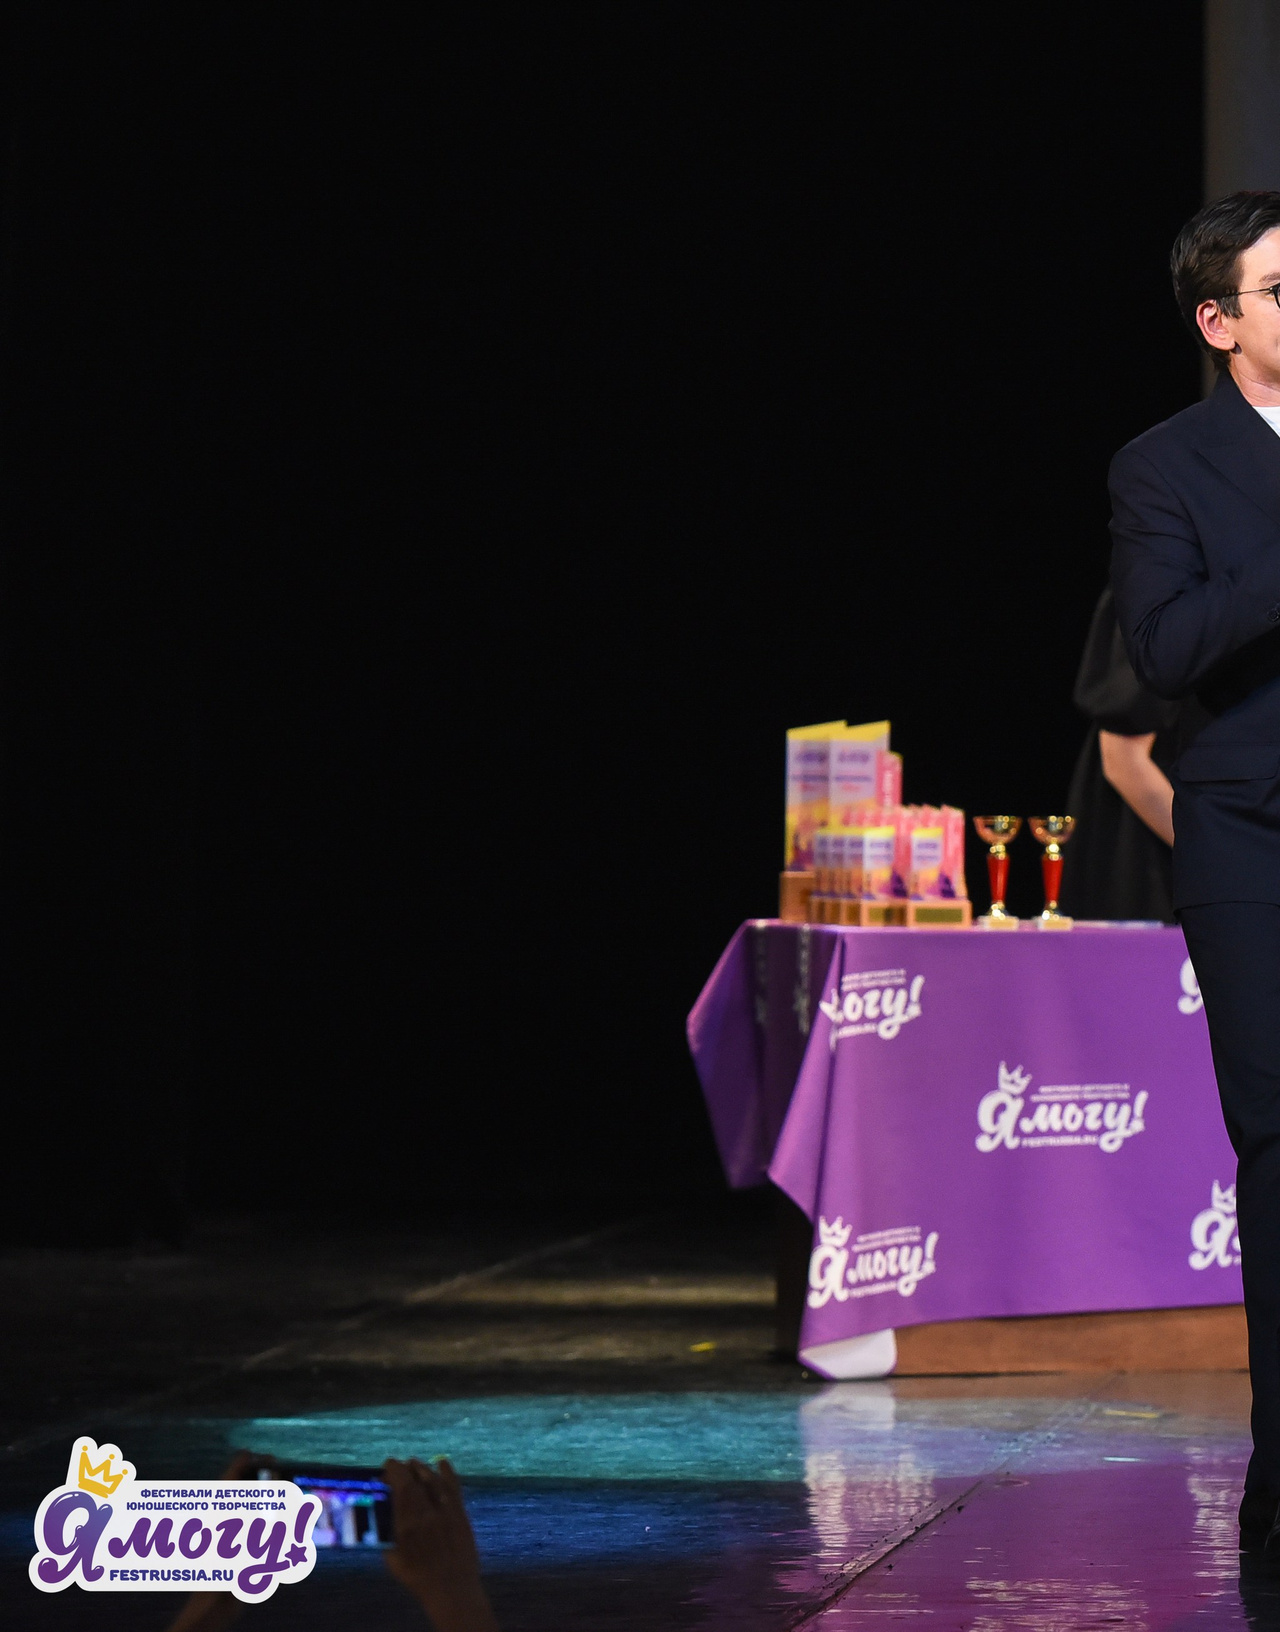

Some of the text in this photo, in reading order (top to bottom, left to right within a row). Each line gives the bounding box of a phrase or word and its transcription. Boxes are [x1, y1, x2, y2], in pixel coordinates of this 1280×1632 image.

[975, 1089, 1149, 1153] Я могу!
[807, 1244, 849, 1309] Я
[846, 1231, 939, 1297] могу!
